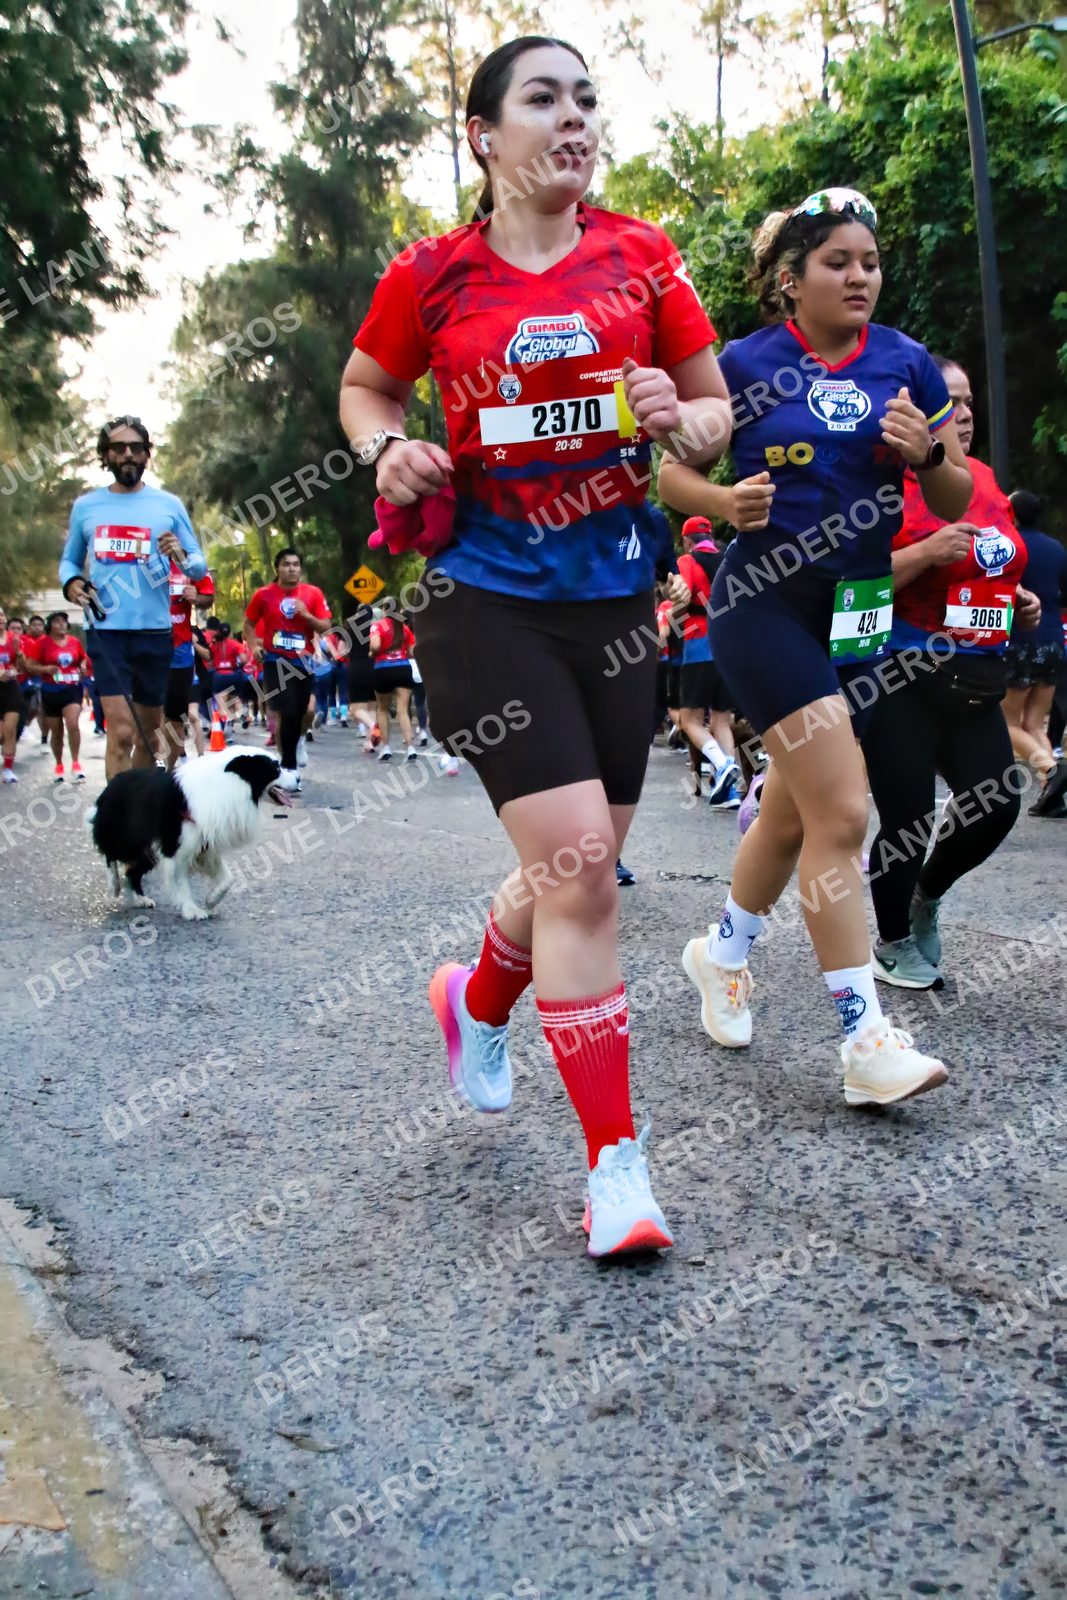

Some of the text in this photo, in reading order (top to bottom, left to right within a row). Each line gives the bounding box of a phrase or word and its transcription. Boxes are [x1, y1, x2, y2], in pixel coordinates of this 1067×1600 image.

[528, 322, 576, 333] BIMBO
[529, 335, 576, 352] Global
[532, 399, 602, 438] 2370
[620, 446, 637, 458] 5K
[110, 540, 132, 551] 2817
[857, 610, 878, 635] 424
[970, 608, 1002, 628] 3068
